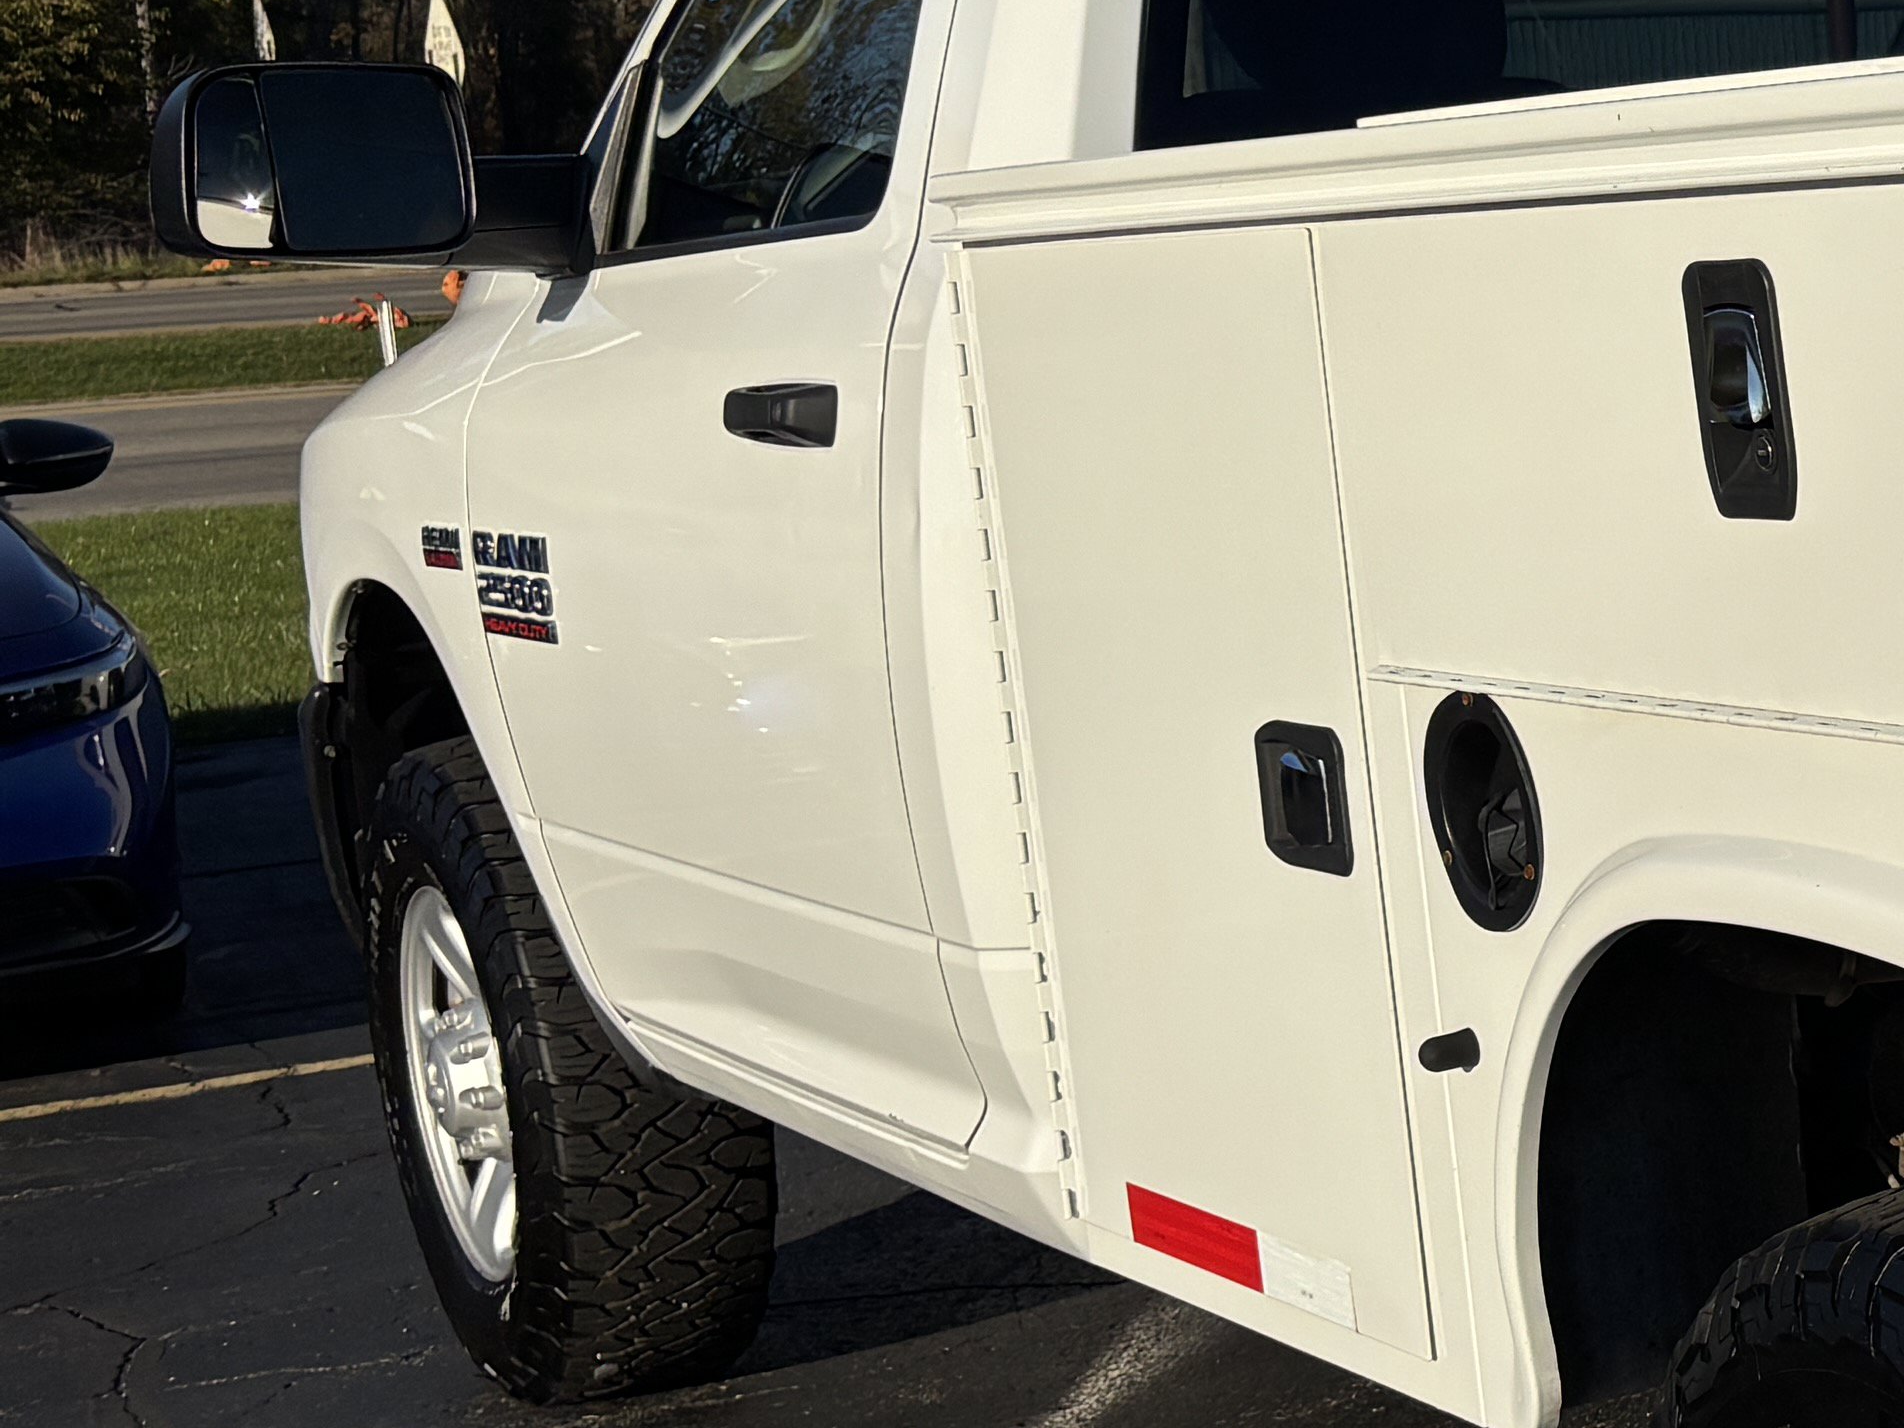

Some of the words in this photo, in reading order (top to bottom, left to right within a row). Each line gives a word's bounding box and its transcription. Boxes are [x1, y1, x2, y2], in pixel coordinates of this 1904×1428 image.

[473, 531, 549, 573] RAM
[477, 572, 554, 616] 2500
[485, 618, 517, 633] HEAVY
[518, 623, 548, 639] DUTY
